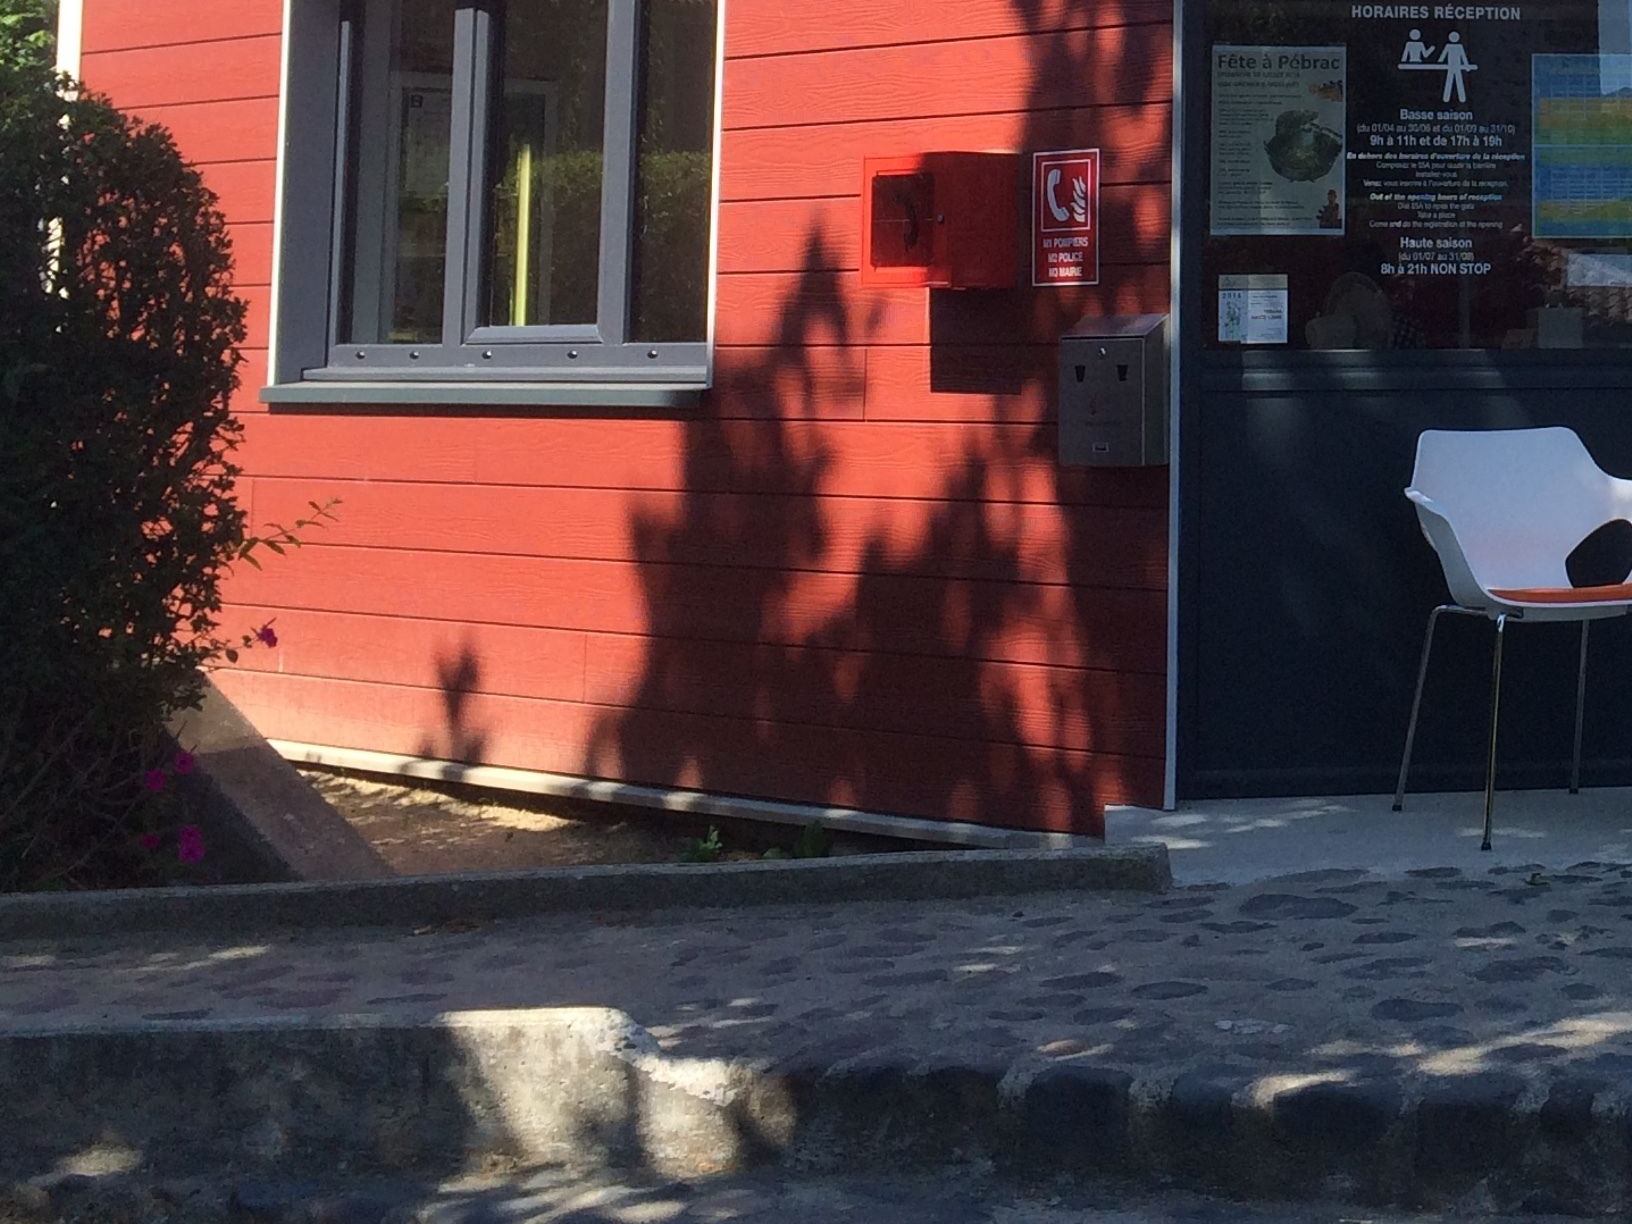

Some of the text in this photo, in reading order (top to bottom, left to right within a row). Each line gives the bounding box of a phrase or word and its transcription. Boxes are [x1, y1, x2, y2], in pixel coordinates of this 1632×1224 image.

[1351, 2, 1521, 20] HORAIRES RÉCEPTION
[1217, 53, 1340, 71] Fête à Pébrac
[1400, 108, 1473, 121] Basse saison
[1369, 134, 1503, 147] 9h à 11h et de 17h à 19h
[1053, 237, 1088, 248] POMPIERS
[1400, 236, 1473, 249] Haute saison
[1058, 252, 1083, 263] POLICE
[1059, 266, 1083, 277] MAIRIE
[1380, 262, 1492, 275] 8h à 21h NON STOP
